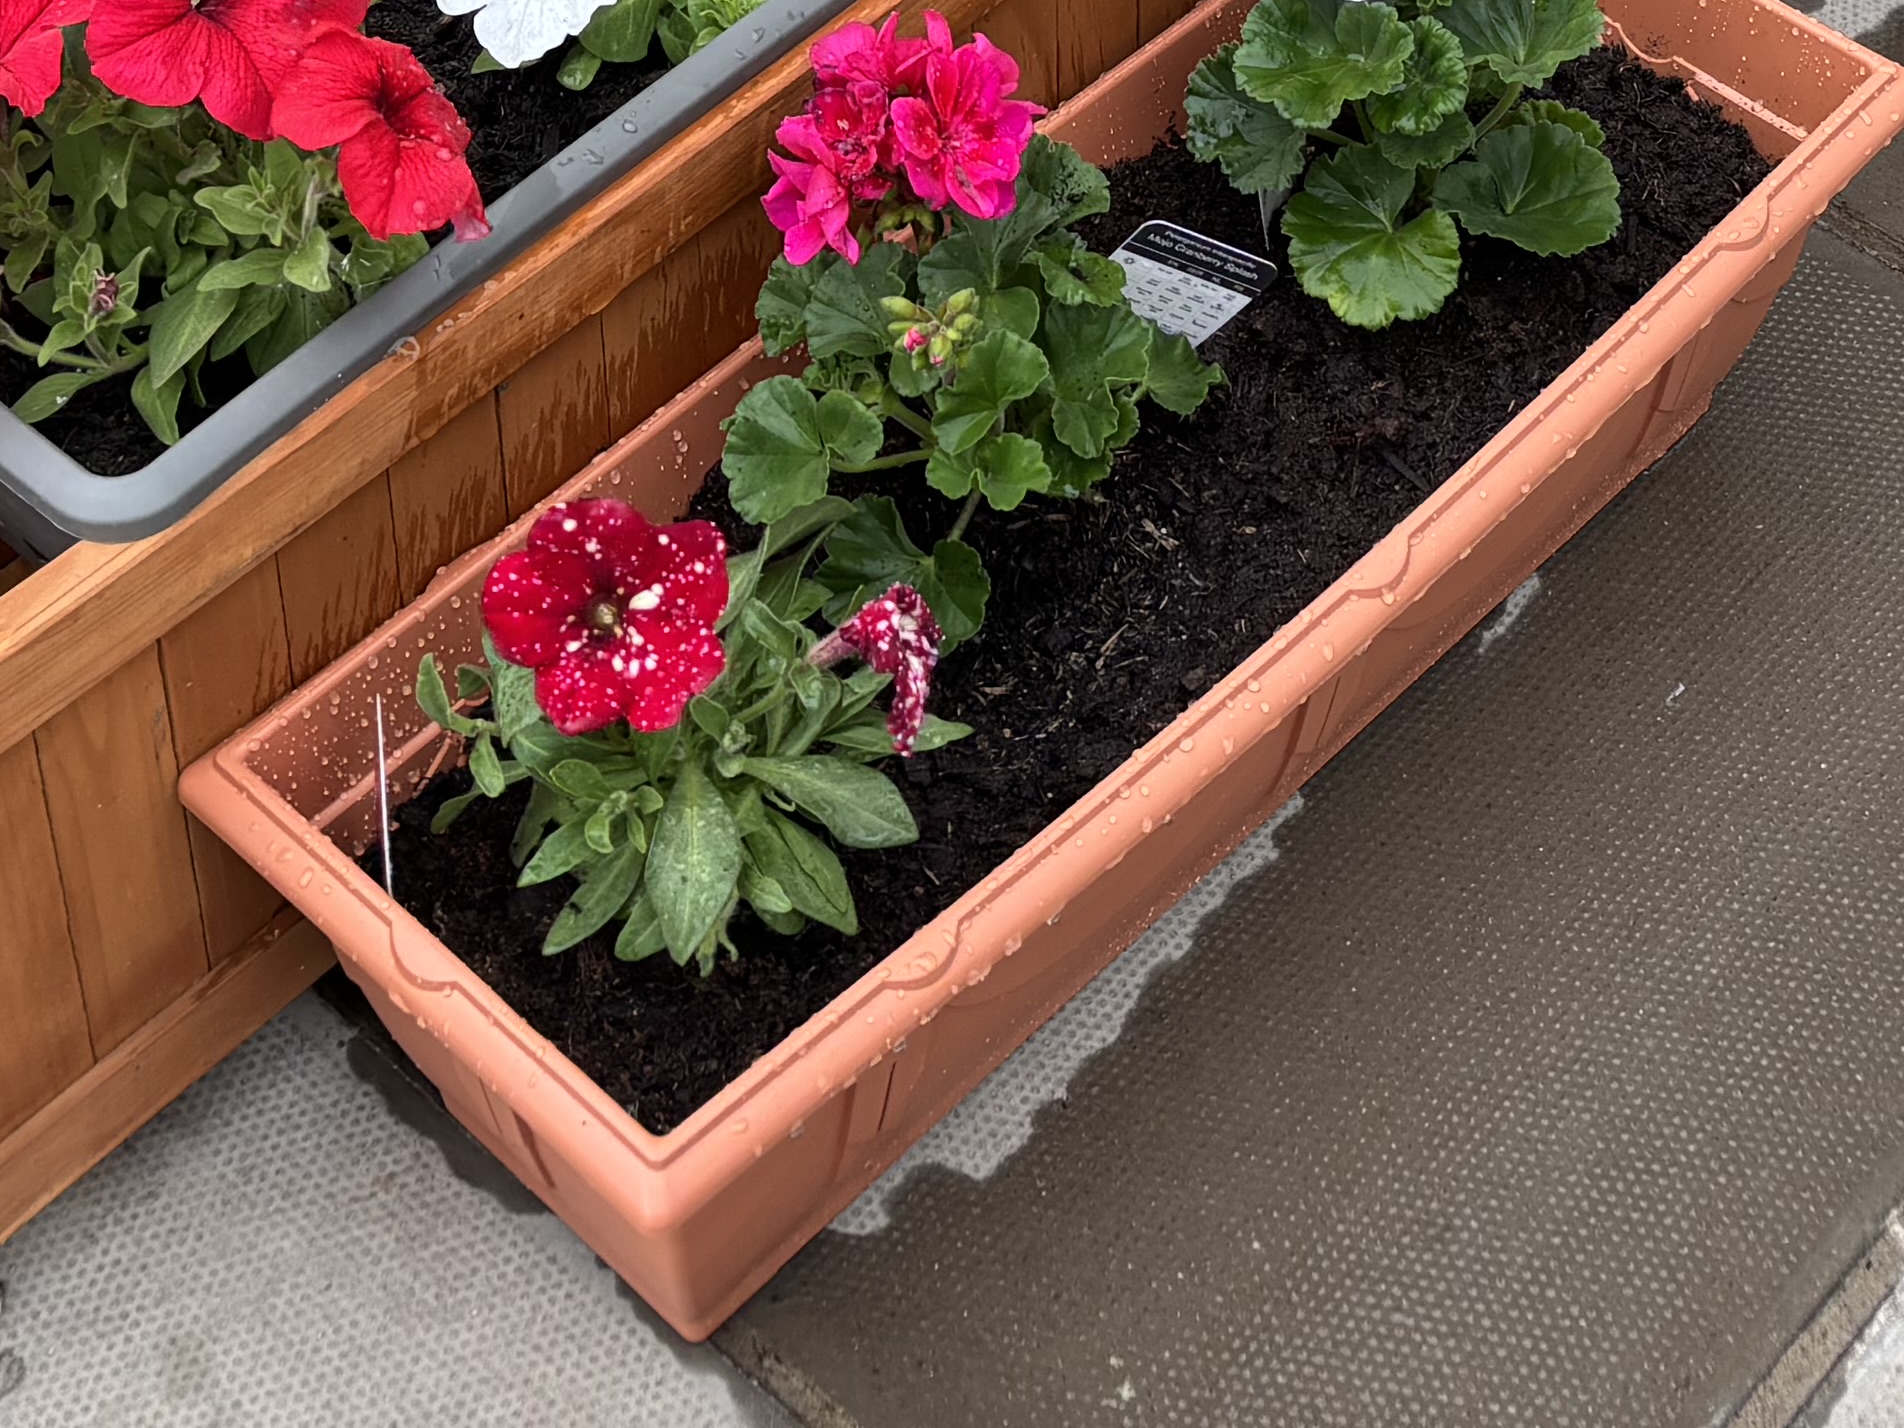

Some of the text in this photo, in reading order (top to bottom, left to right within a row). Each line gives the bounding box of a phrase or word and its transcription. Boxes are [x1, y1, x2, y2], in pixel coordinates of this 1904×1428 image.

[1147, 232, 1174, 248] Mojo
[1174, 243, 1224, 268] Cranberry
[1224, 262, 1259, 281] Splash
